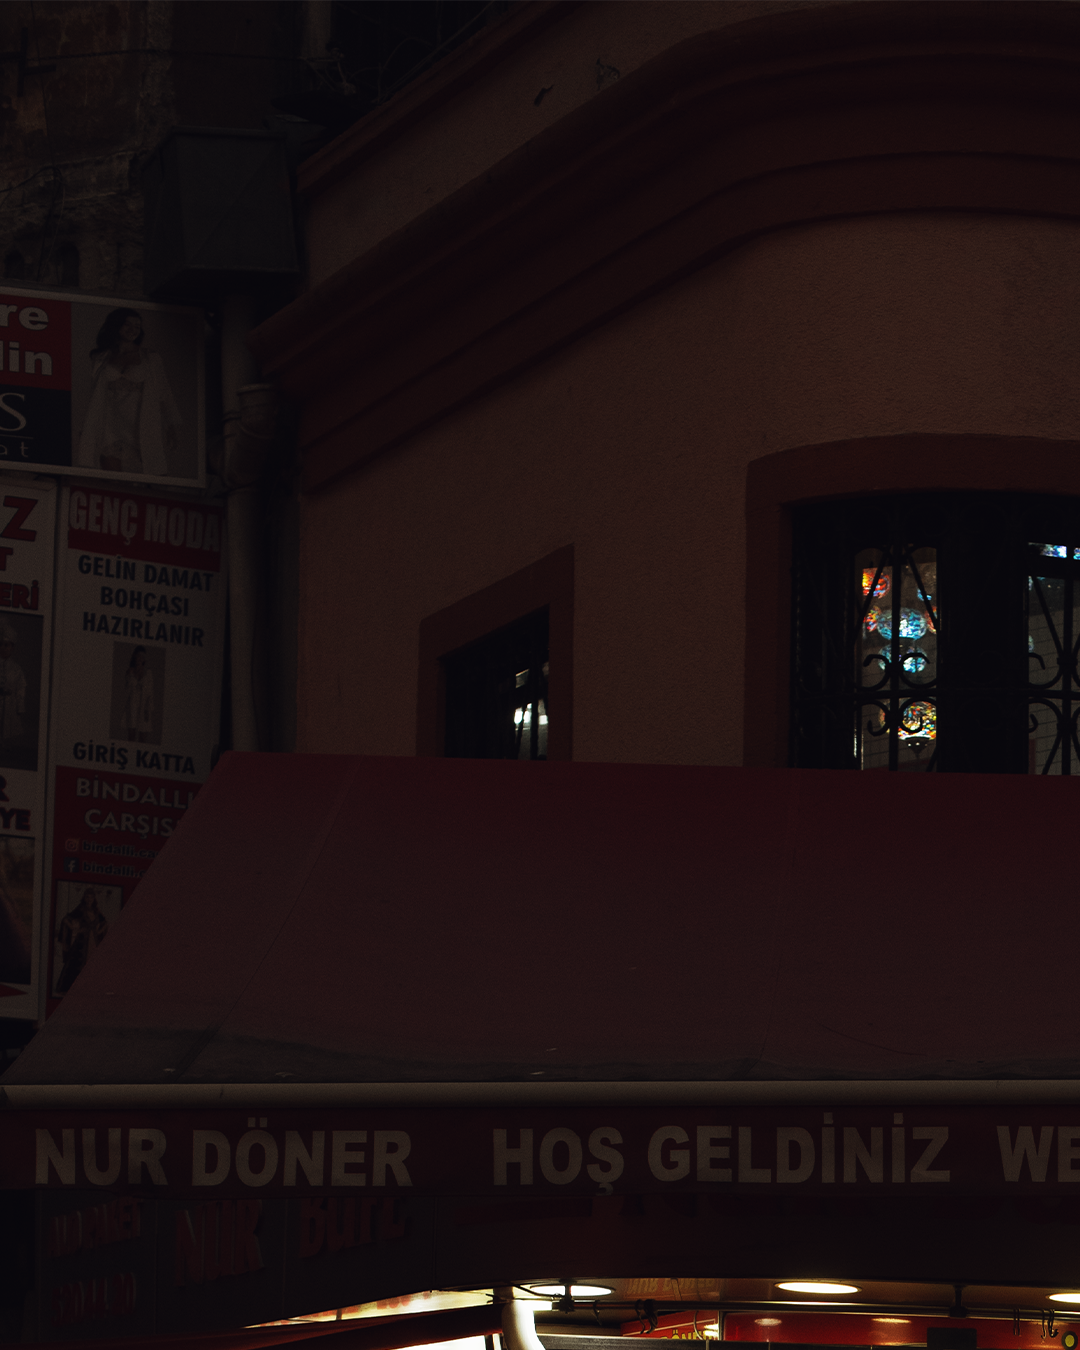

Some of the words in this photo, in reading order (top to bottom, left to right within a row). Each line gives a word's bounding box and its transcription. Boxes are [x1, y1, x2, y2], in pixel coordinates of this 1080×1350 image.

[69, 491, 138, 546] GENÇ
[144, 503, 220, 553] MODA
[78, 555, 136, 582] GELİN
[144, 565, 214, 593] DAMAT
[100, 587, 189, 617] BOHÇASI
[83, 611, 205, 646] HAZIRLANIR
[73, 740, 128, 770] GİRİŞ
[136, 750, 195, 775] KATTA
[84, 809, 181, 840] ÇARŞIS
[35, 1128, 168, 1187] NUR
[191, 1117, 413, 1188] DÖNER
[492, 1126, 625, 1197] HOŞ
[648, 1112, 951, 1184] GELDİNİZ
